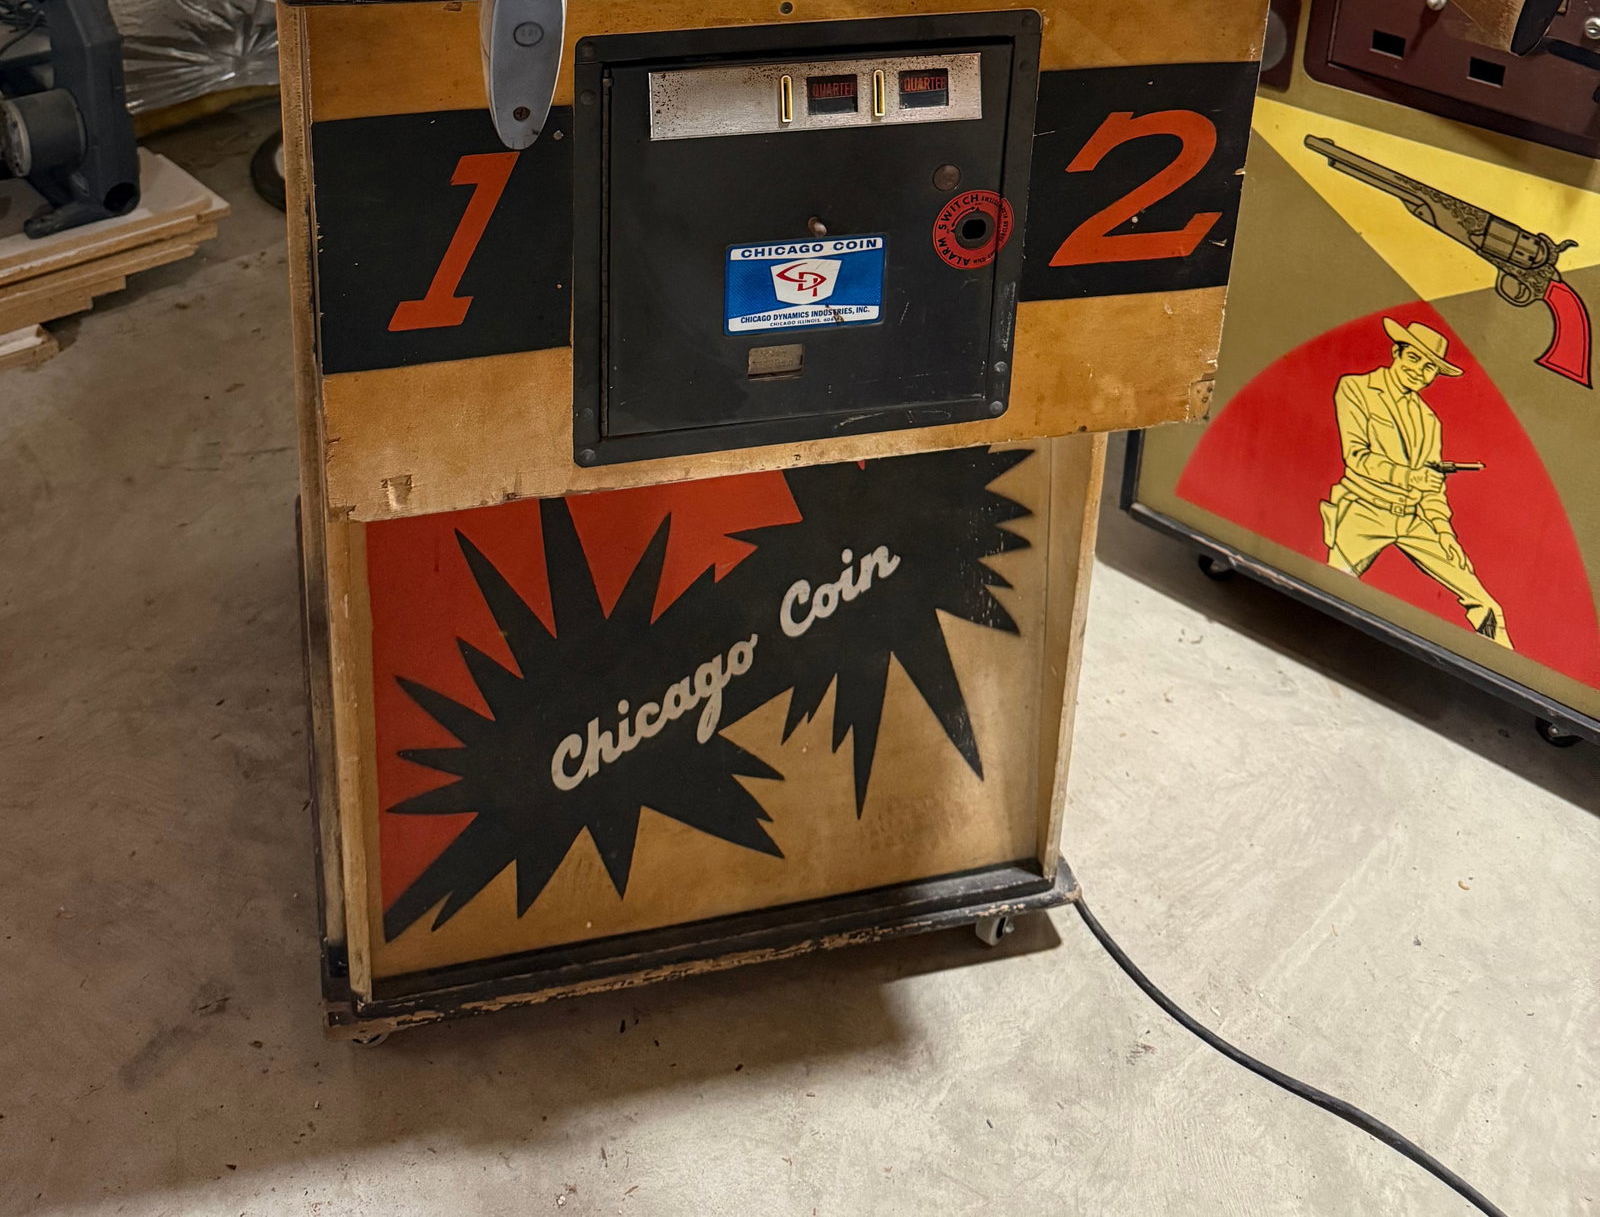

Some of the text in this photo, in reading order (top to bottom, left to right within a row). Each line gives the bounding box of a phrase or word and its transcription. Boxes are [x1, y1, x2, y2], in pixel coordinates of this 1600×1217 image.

[938, 194, 978, 230] SWITCH
[1048, 109, 1223, 267] 2
[387, 152, 520, 332] 1
[741, 239, 877, 258] CHICAGO COIN
[938, 238, 970, 266] ALARM
[740, 315, 771, 323] CHICAGO
[773, 312, 809, 320] DYNAMICS
[780, 545, 901, 637] Coin
[552, 634, 758, 791] Chicago
